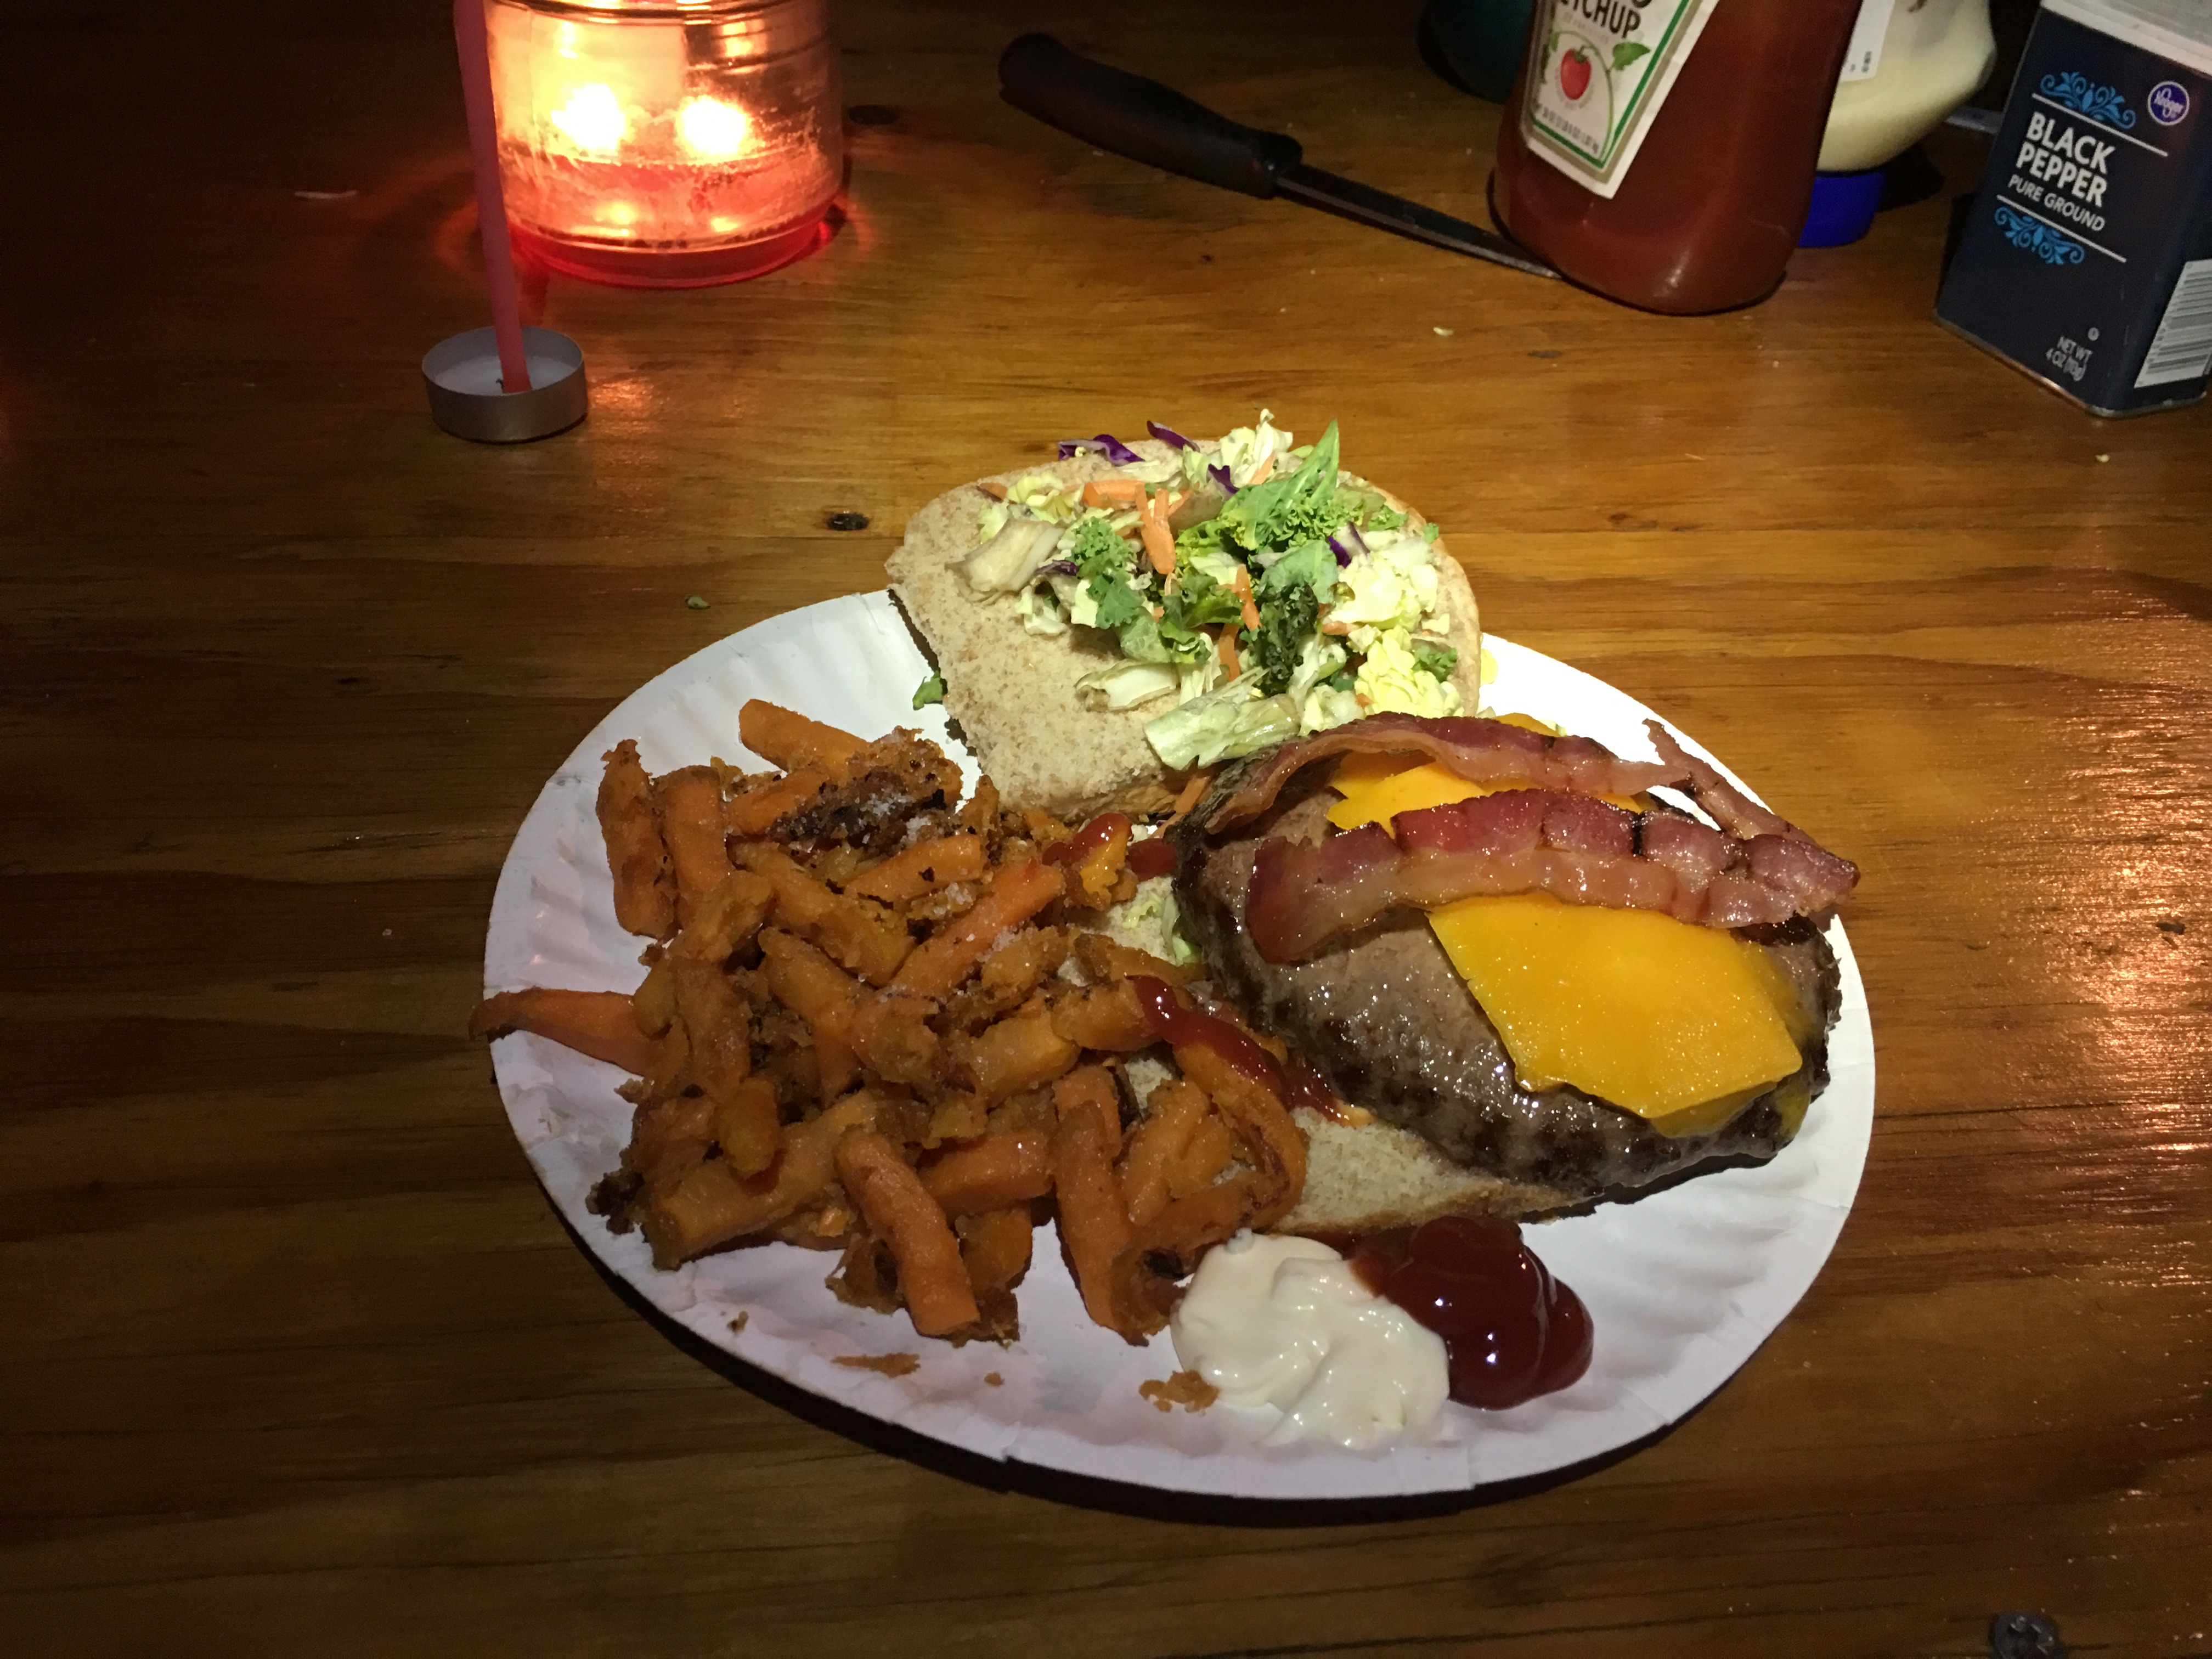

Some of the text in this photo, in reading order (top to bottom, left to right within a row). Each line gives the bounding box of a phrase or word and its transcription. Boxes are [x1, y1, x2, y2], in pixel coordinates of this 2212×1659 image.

[1560, 0, 1641, 39] CHUP
[2026, 111, 2115, 174] BLACK
[2016, 141, 2107, 207] PEPPER
[2007, 174, 2105, 231] PURE GROUND
[2052, 351, 2066, 368] OZ
[2057, 336, 2092, 363] NET WT
